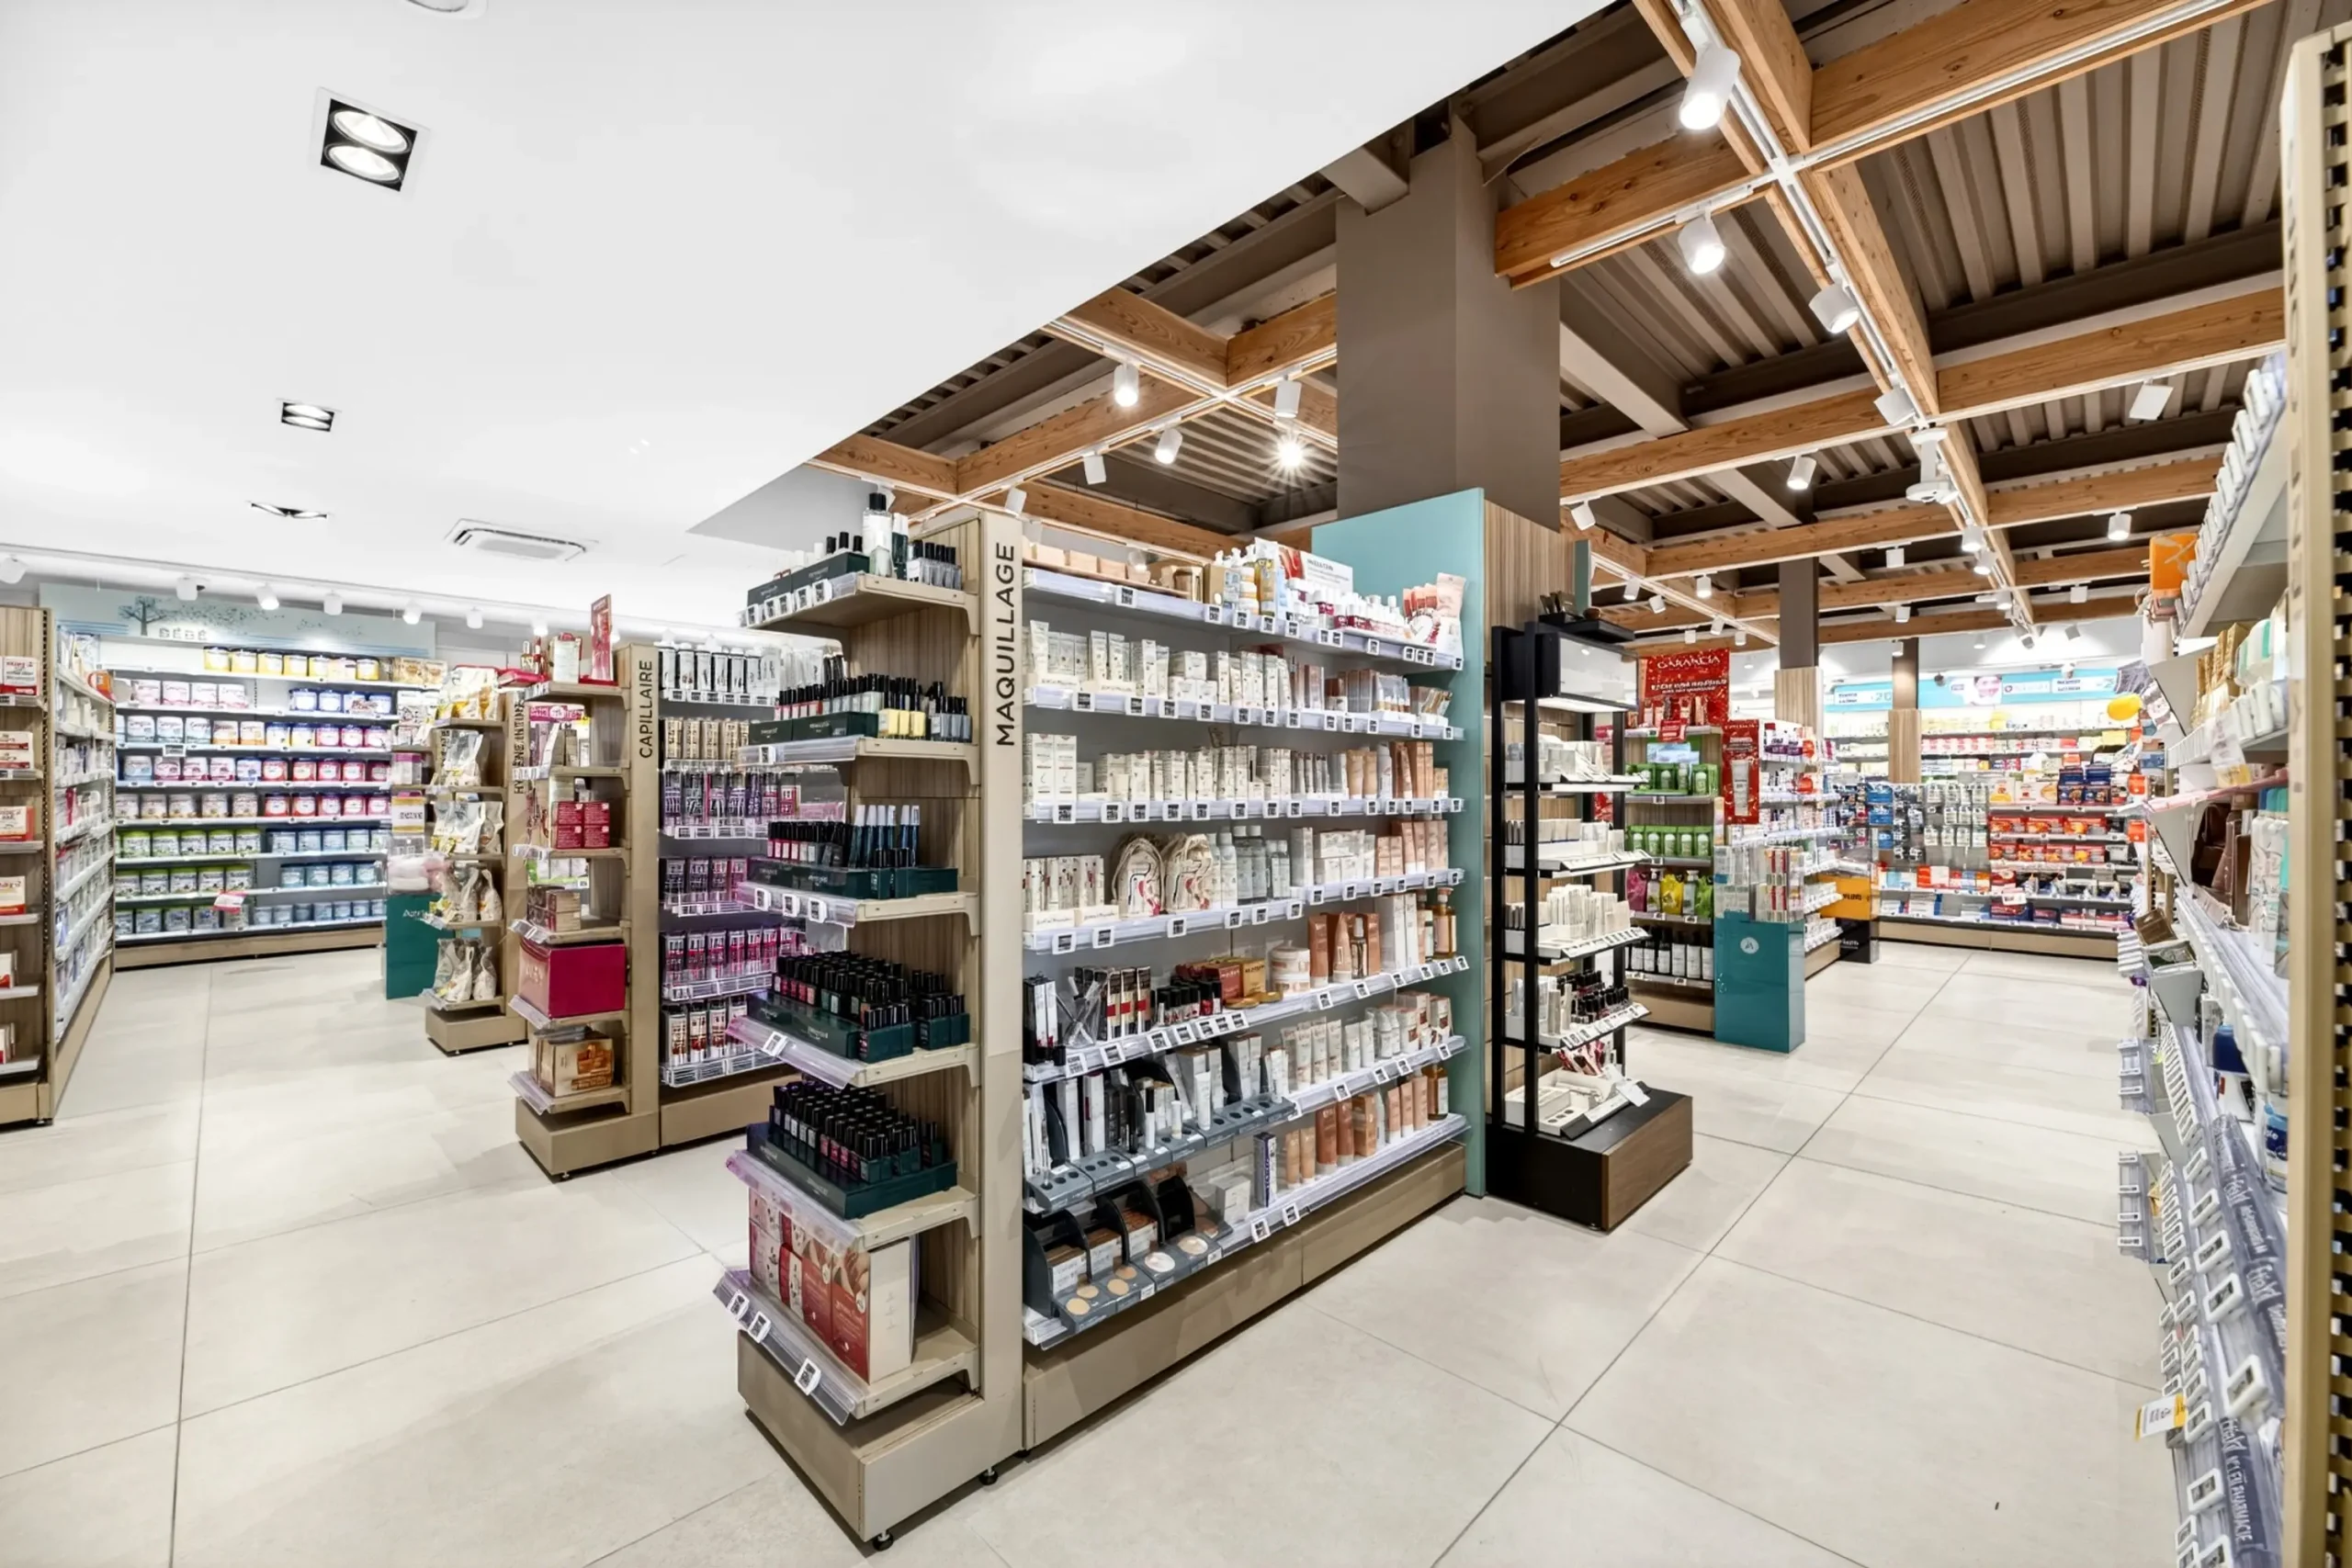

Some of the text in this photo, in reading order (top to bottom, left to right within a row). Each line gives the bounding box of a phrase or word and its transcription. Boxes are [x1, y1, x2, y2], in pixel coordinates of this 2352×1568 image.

[996, 542, 1015, 746] MAQUILLAGE
[639, 660, 653, 759] CAPILLAIRE
[512, 743, 525, 795] HYÈNE
